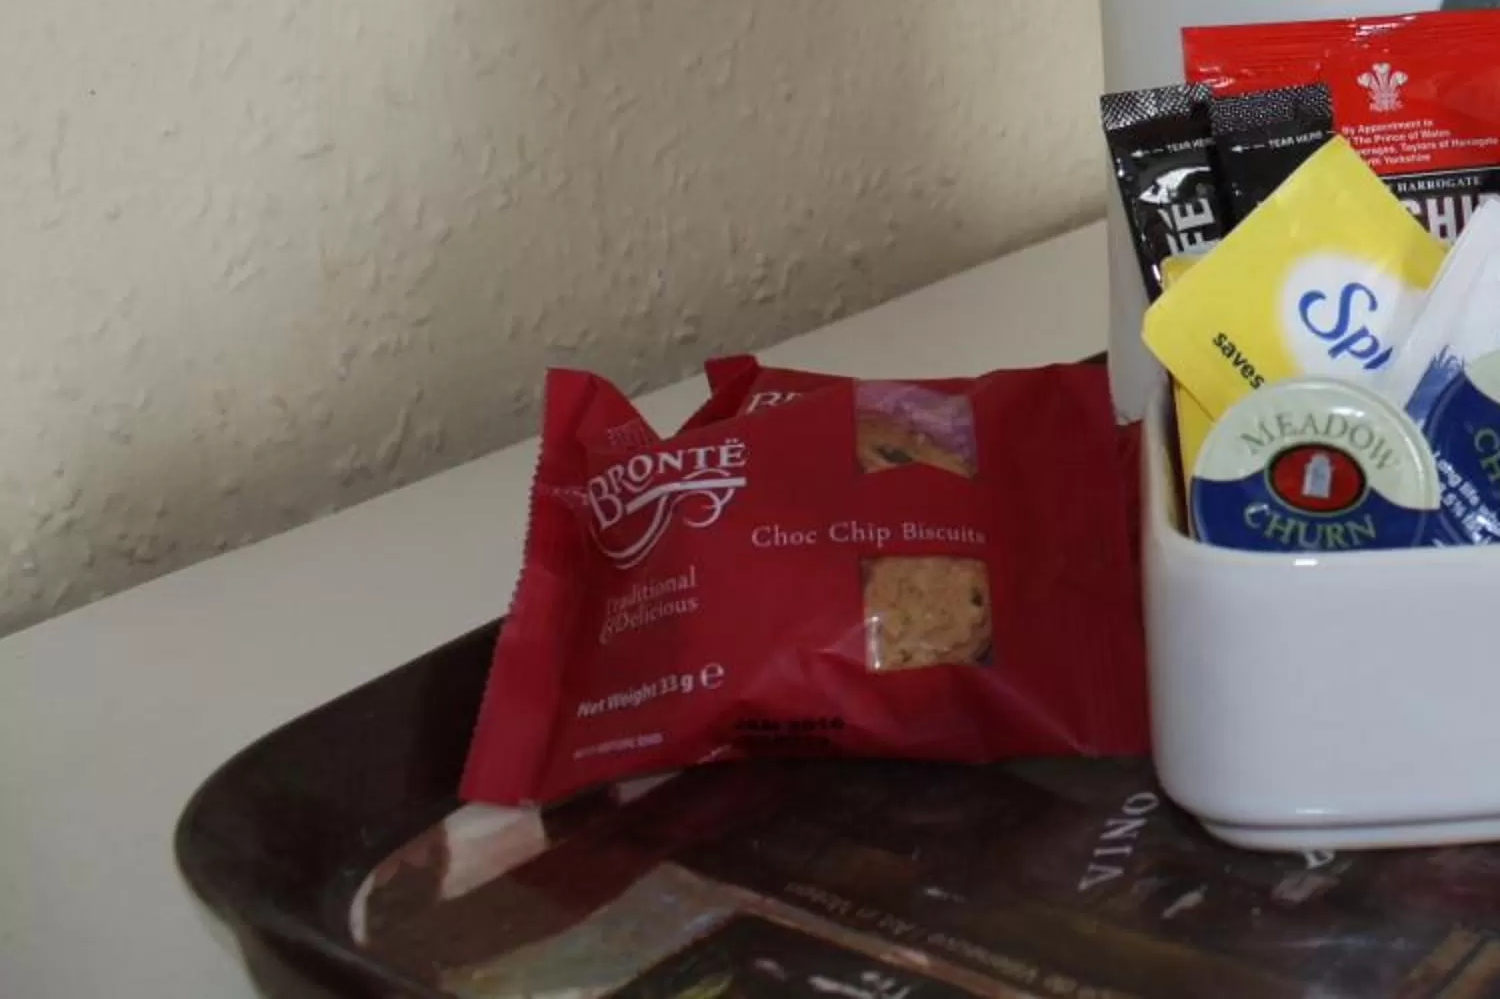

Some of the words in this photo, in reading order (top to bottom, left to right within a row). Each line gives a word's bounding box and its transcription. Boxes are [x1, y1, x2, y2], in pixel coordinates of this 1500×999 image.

[1167, 140, 1192, 153] TEAR
[1193, 137, 1215, 150] HER
[1268, 135, 1295, 149] TEAR
[1373, 133, 1406, 144] Prince
[1401, 141, 1437, 153] Taylors
[1397, 176, 1481, 192] HARROGATE
[1212, 332, 1266, 391] saves
[1240, 411, 1395, 471] MEADOW
[750, 523, 818, 548] Choc
[828, 520, 892, 550] Chip
[903, 522, 987, 545] Biscuits
[1243, 503, 1377, 551] CHURN
[607, 564, 697, 615] Traditional
[577, 699, 607, 718] Net
[608, 682, 658, 710] Weight
[1077, 792, 1160, 892] VINO
